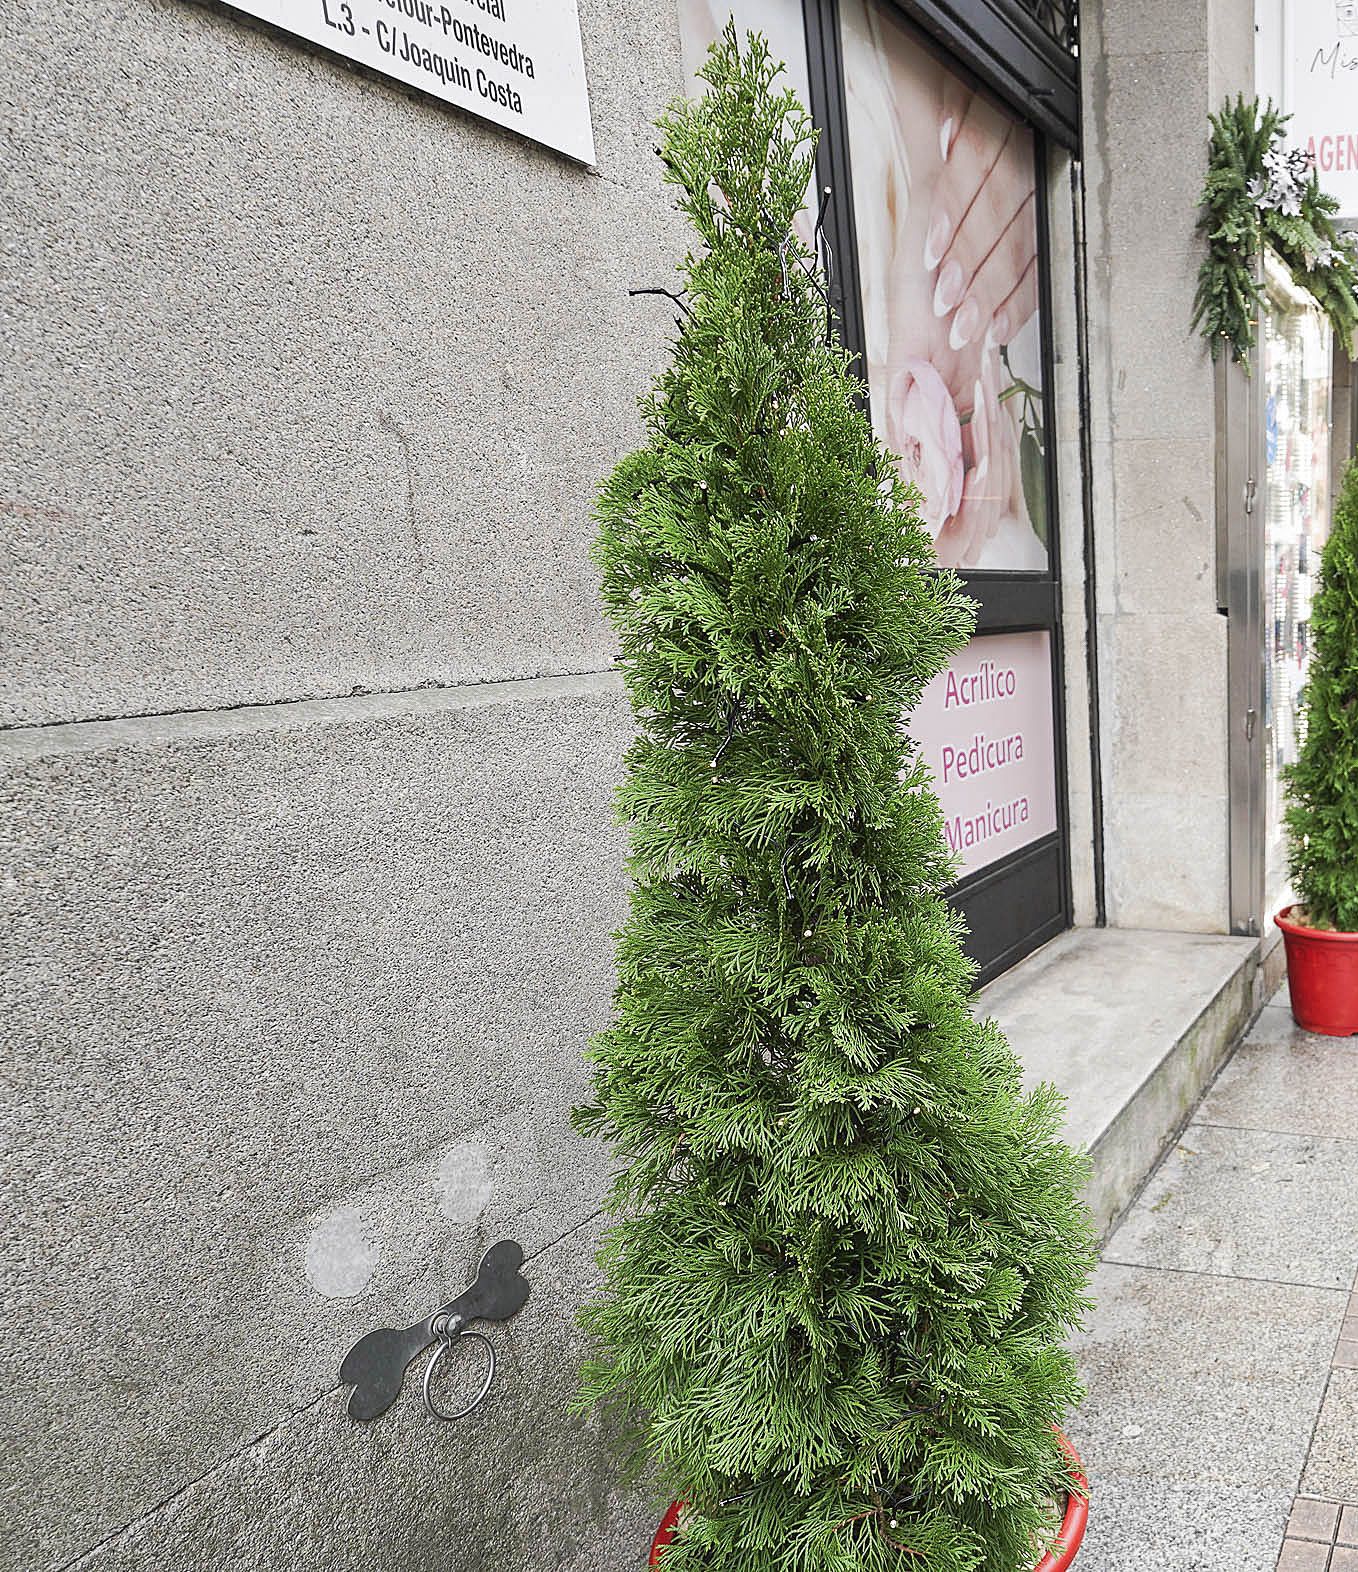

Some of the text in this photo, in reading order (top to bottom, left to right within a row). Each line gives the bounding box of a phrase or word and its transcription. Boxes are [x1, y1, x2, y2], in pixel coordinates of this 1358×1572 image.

[321, 0, 356, 36] L.3
[476, 68, 523, 115] Costa
[944, 663, 1017, 709] Acrílico
[942, 733, 1025, 784] Pedicura
[944, 797, 1030, 852] Manicura
